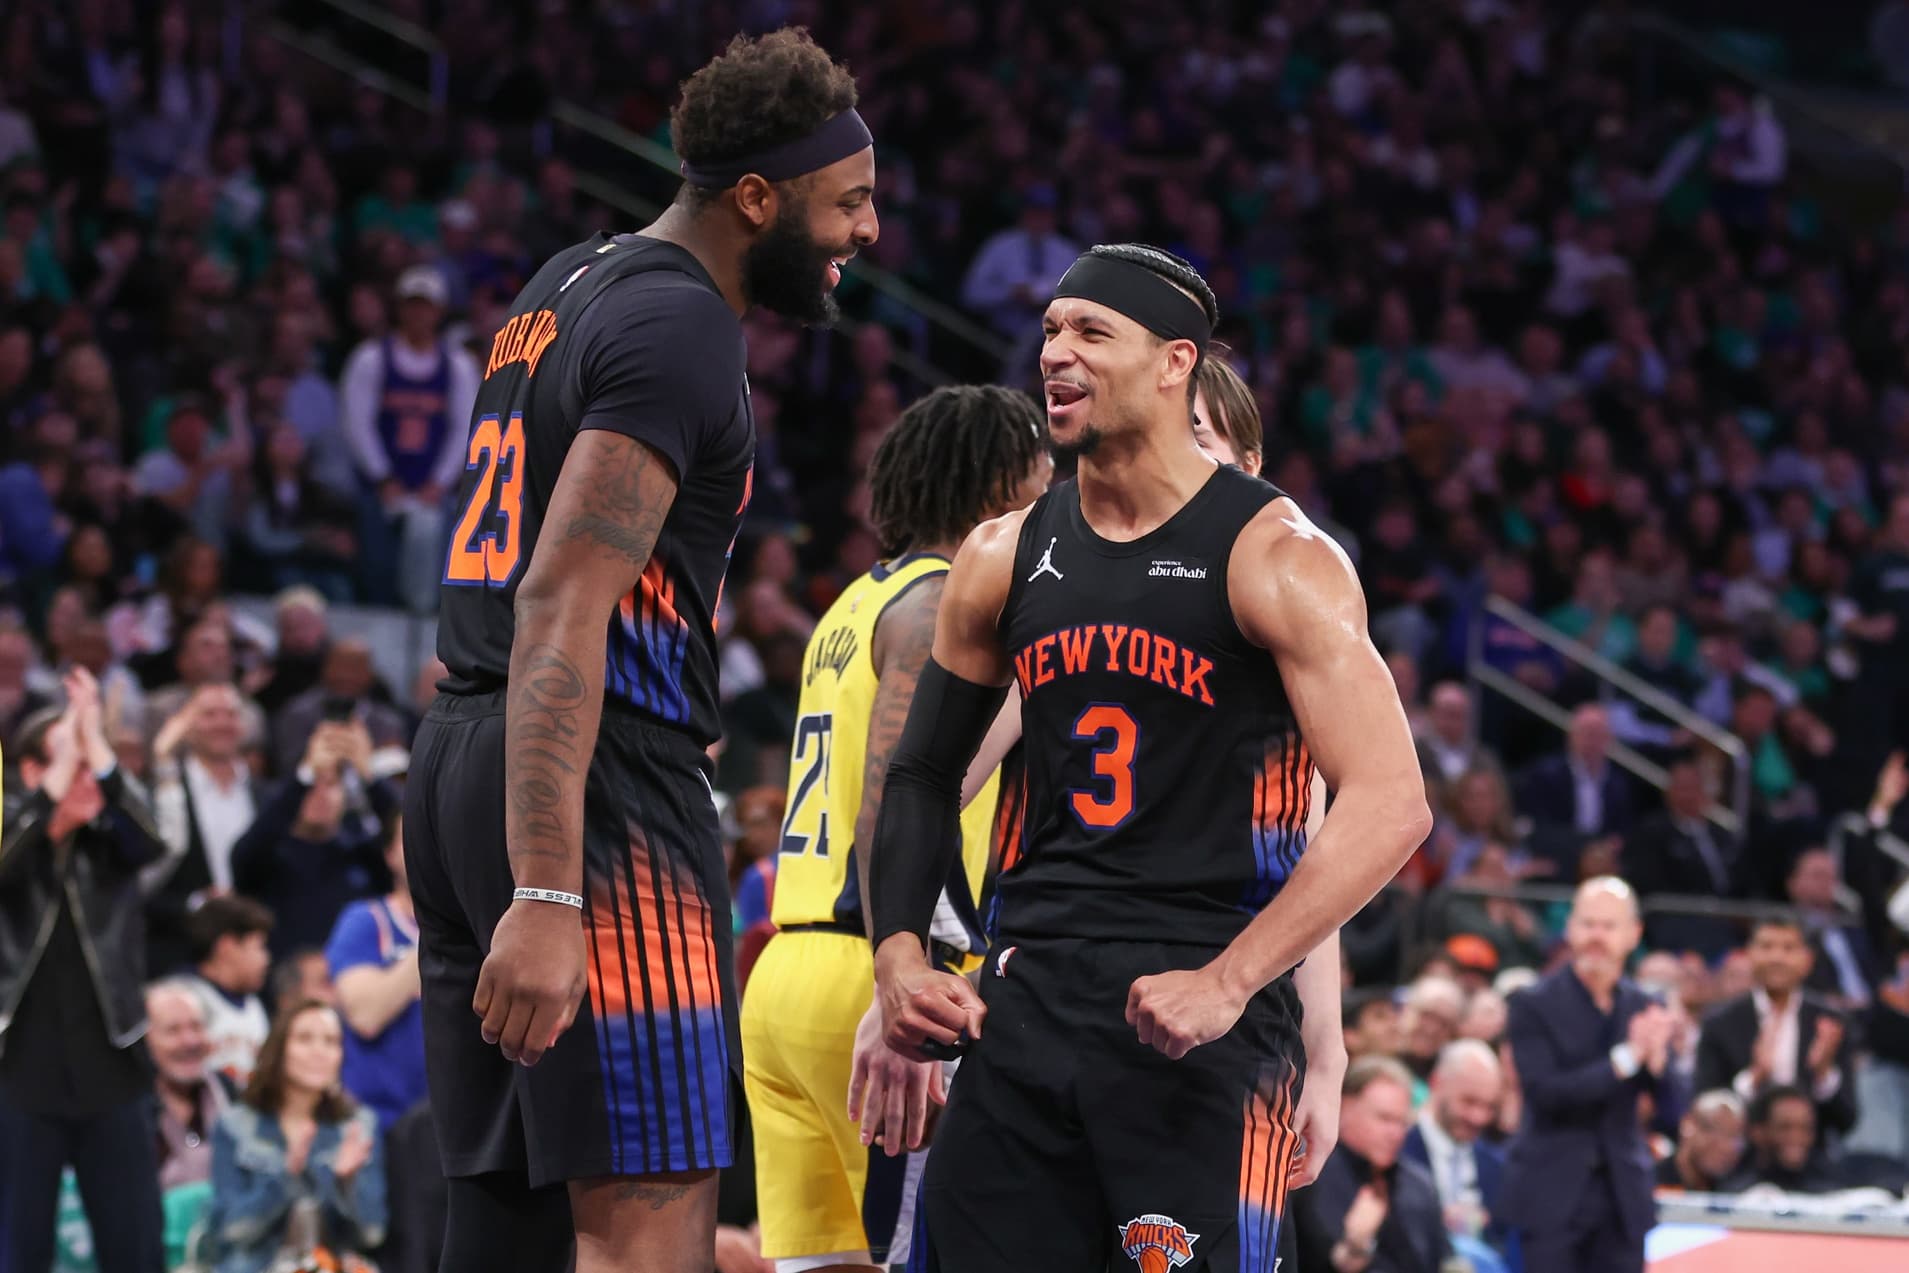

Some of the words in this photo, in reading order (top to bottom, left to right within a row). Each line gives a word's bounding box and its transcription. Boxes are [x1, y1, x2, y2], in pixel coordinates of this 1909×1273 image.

[442, 410, 526, 588] 23
[1148, 566, 1171, 577] abu
[1171, 566, 1207, 579] dhabi
[1014, 625, 1098, 701] NEW
[1101, 624, 1215, 707] YORK
[1068, 701, 1140, 832] 3
[1124, 1222, 1191, 1258] KNICKS
